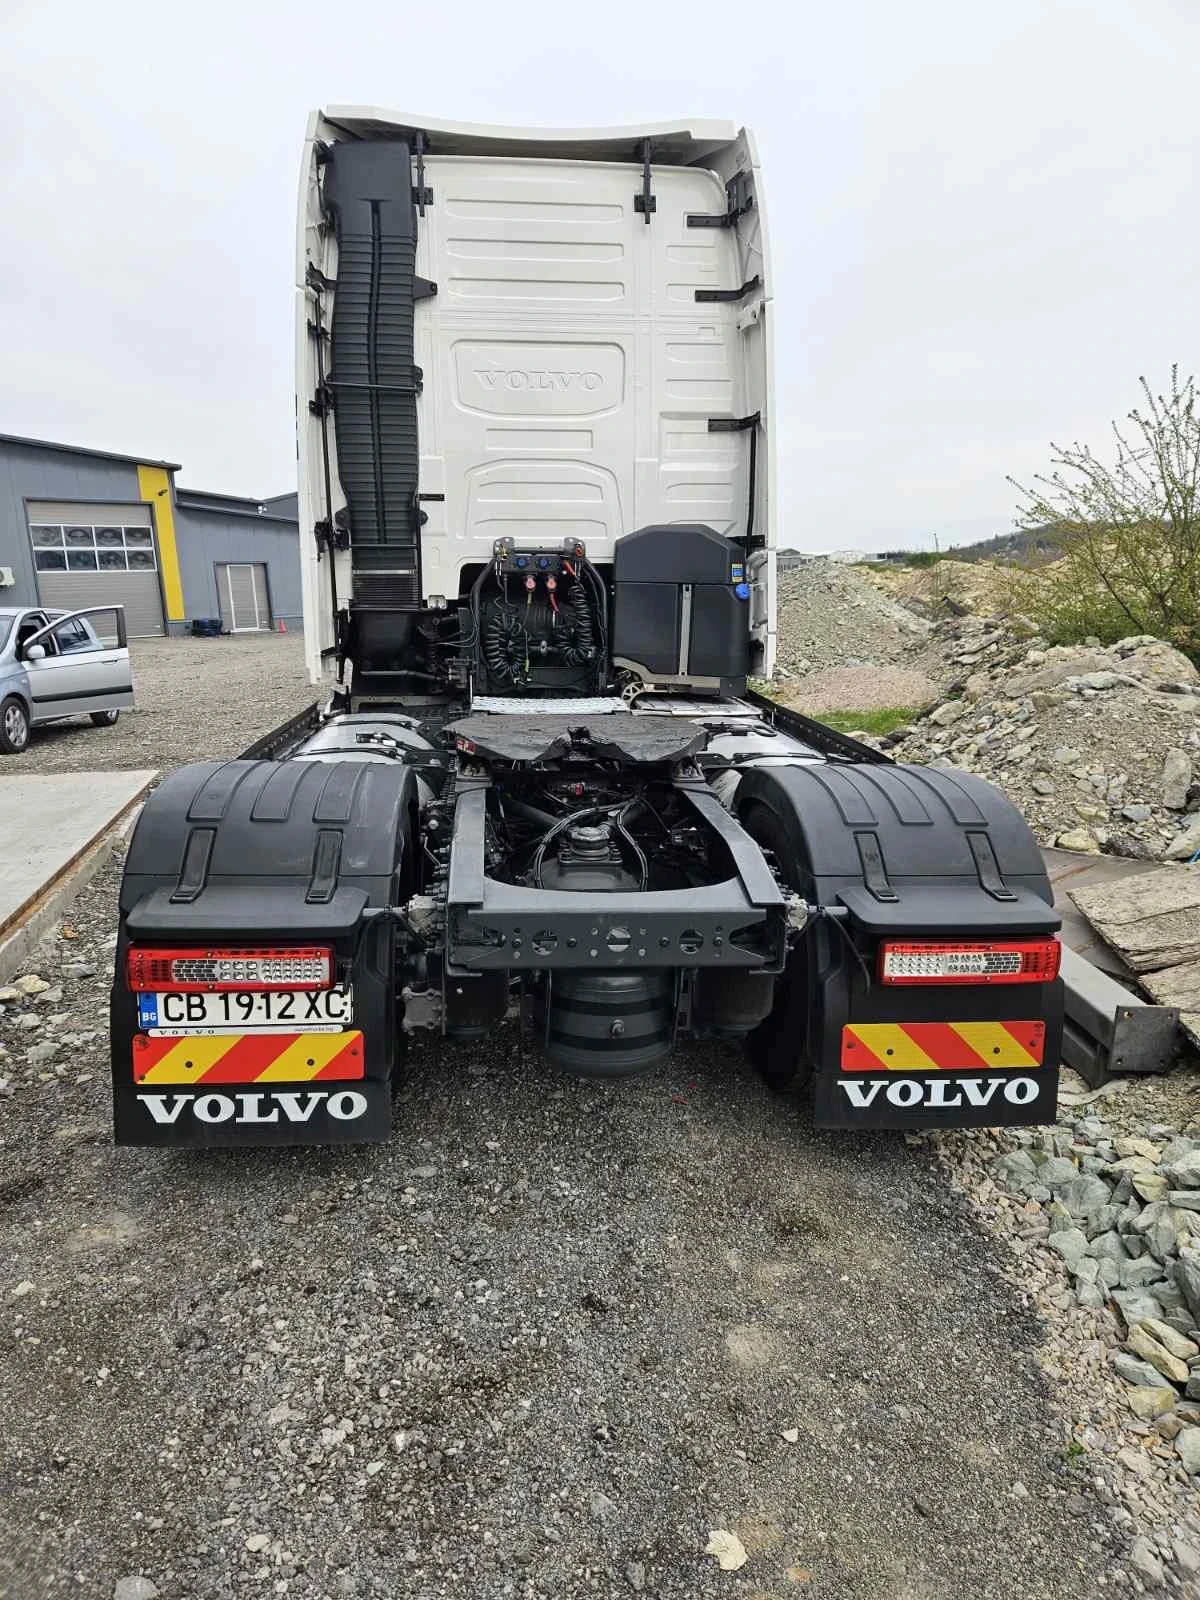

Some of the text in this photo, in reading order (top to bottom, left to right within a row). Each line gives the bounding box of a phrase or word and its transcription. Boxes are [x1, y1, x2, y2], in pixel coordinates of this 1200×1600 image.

[472, 369, 605, 392] VOLVO
[142, 1012, 157, 1022] BG
[163, 990, 346, 1022] CB 1912 XC
[136, 1091, 368, 1124] VOLVO
[836, 1077, 1040, 1108] VOLVO
